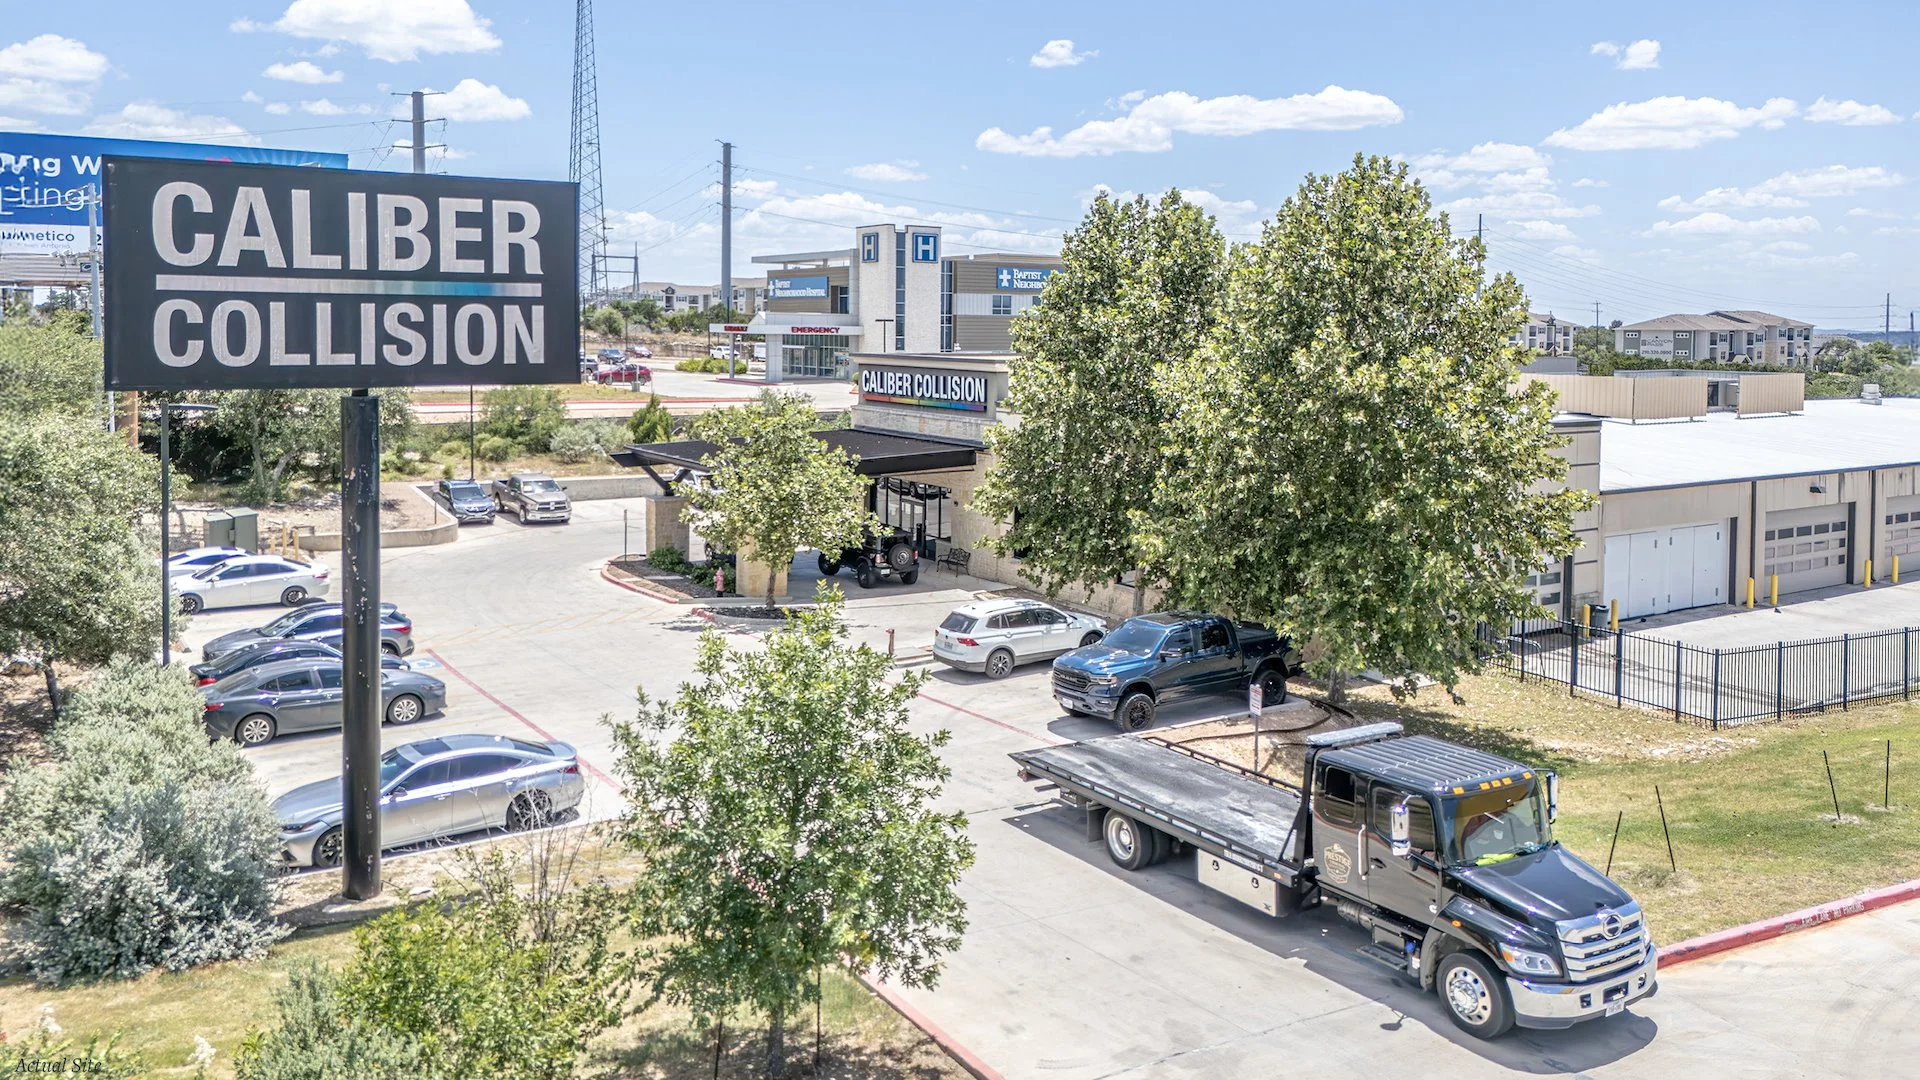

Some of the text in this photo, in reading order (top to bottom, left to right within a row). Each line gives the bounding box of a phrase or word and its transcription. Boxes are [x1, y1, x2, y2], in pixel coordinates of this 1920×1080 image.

[152, 181, 544, 275] CALIBER
[864, 236, 875, 260] H
[918, 236, 934, 260] H
[1013, 268, 1042, 280] BAPTIST
[154, 299, 545, 368] COLLISION
[791, 326, 840, 334] EMERGENCY
[862, 370, 985, 402] CALIBER COLLISION
